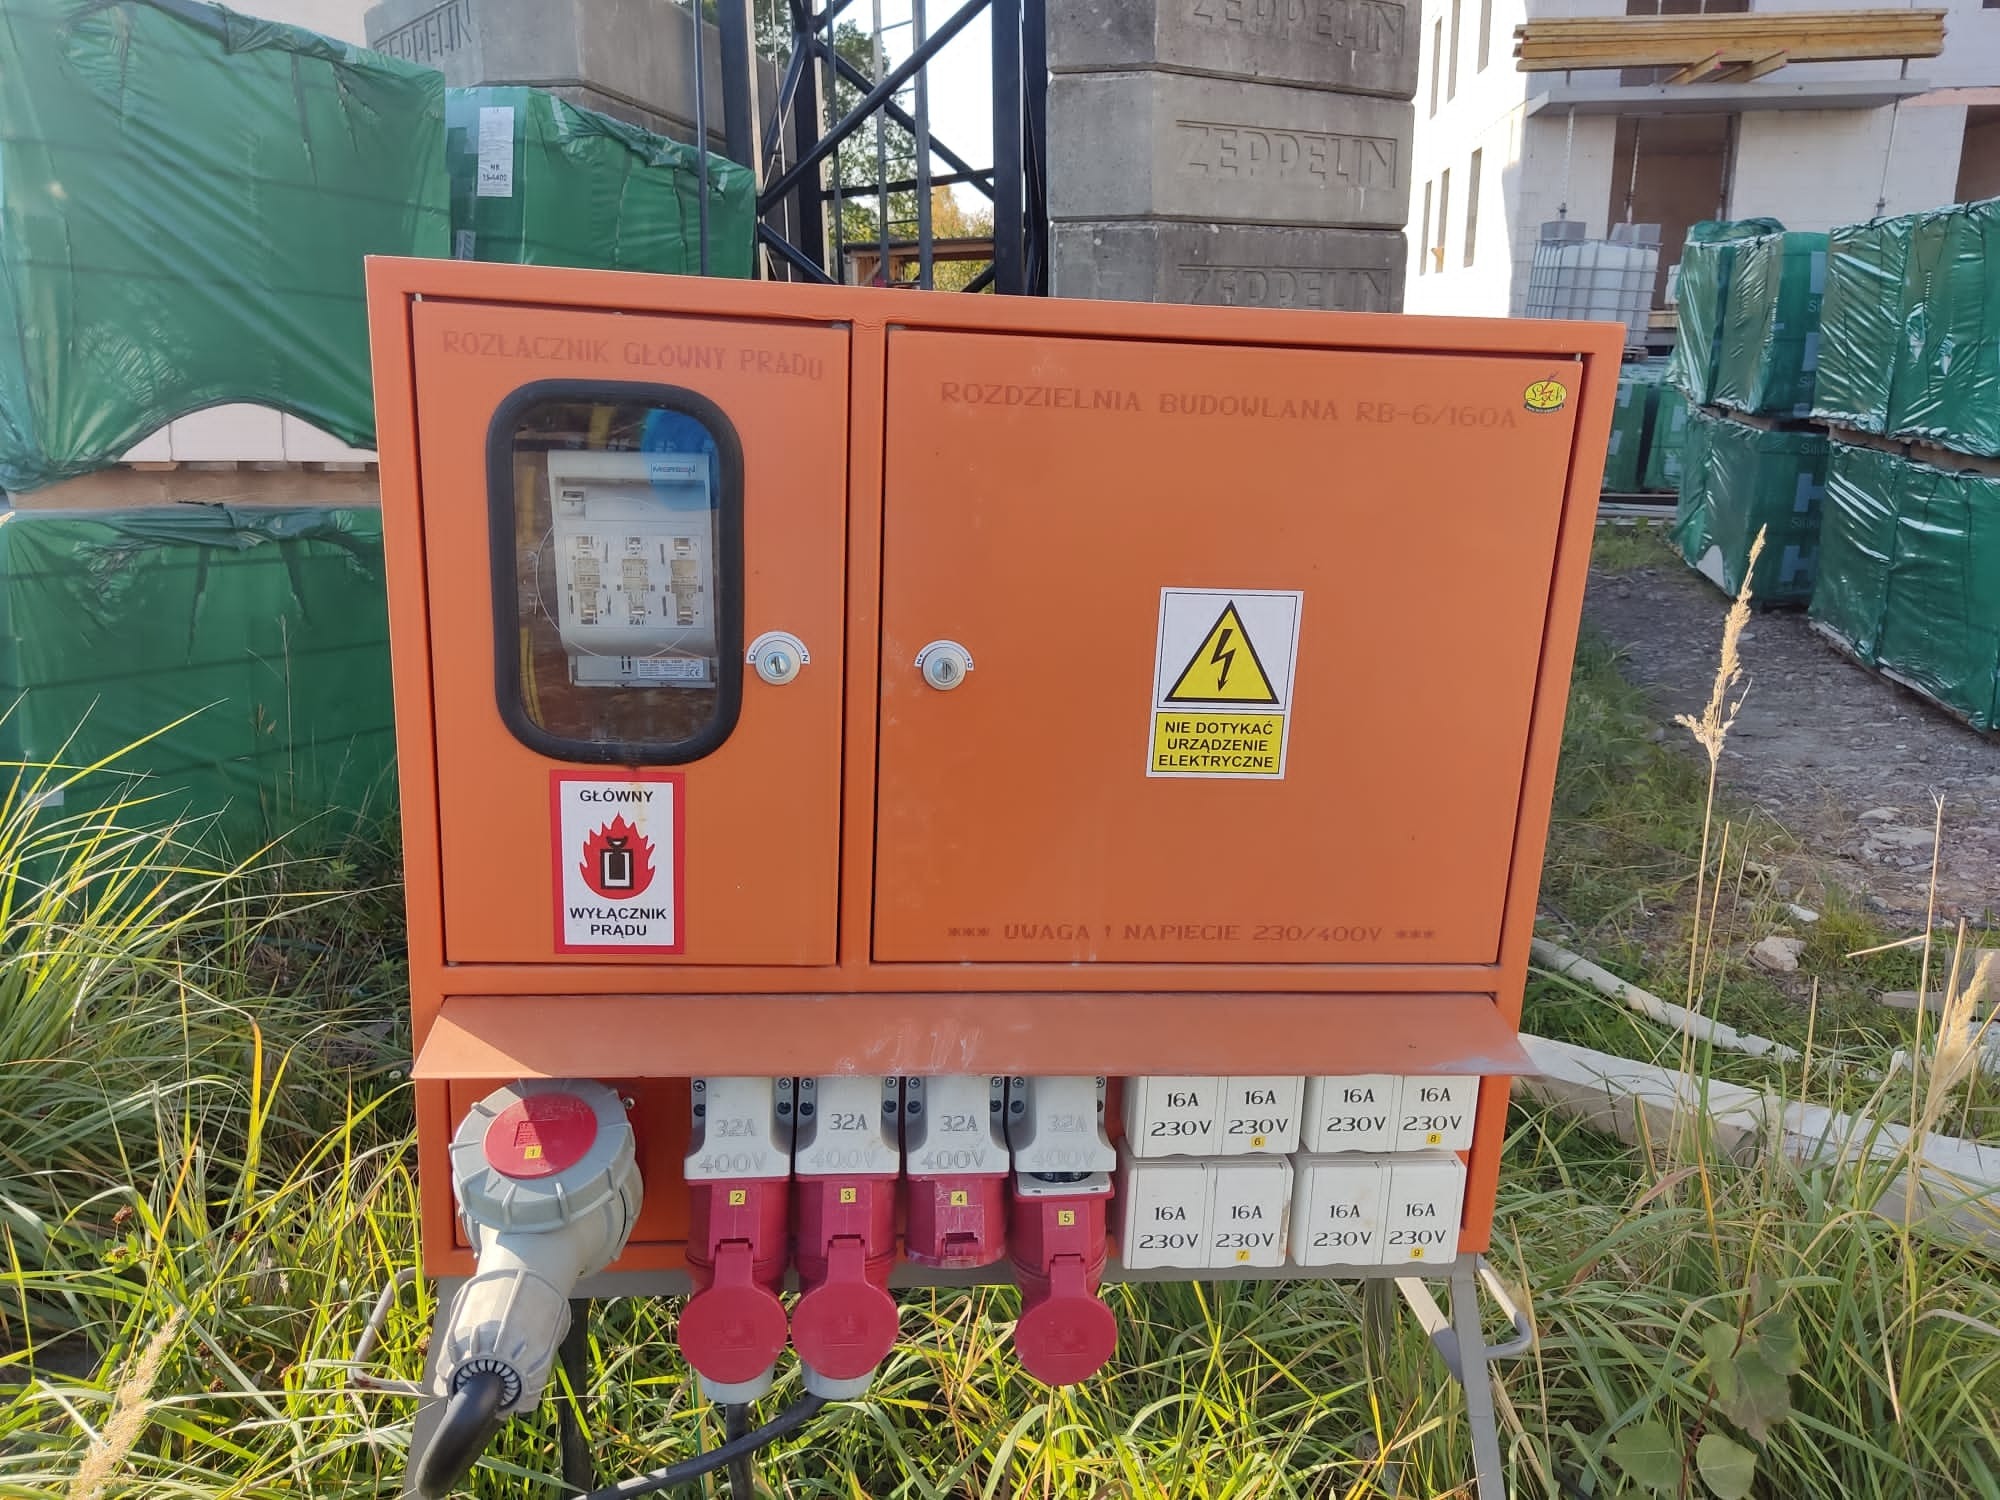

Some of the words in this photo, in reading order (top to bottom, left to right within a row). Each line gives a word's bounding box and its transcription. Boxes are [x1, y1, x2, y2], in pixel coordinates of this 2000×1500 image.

[1177, 124, 1398, 188] ZEPPELIN
[1178, 267, 1392, 311] ZEPPELIN
[740, 348, 824, 381] PRADU
[941, 382, 1143, 412] ROZDZIELNIA
[1159, 393, 1338, 421] BUDOWLANA
[1355, 401, 1517, 429] RB-6/160A
[1165, 722, 1191, 734] NIE
[1196, 721, 1273, 735] DOTYKAĆ
[1167, 738, 1268, 753] URZĄDZENIE
[1159, 754, 1273, 768] ELEKTRYCZNE
[580, 788, 653, 802] GŁÓWNY
[570, 907, 666, 922] WYŁĄCZNIK
[590, 924, 647, 938] PRĄDU
[1004, 924, 1090, 940] UWAGA
[1123, 925, 1240, 941] NAPIECIE
[1252, 925, 1383, 942] 230/400V
[1167, 1092, 1199, 1108] 16A
[1245, 1090, 1276, 1105] 16A
[1343, 1088, 1375, 1103] 16A
[1420, 1087, 1451, 1102] 16A
[716, 1119, 757, 1137] 32A
[829, 1113, 868, 1131] 32A
[939, 1114, 979, 1132] 32A
[1151, 1119, 1212, 1137] 230V
[1228, 1118, 1289, 1135] 230V
[1327, 1116, 1386, 1132] 230V
[1402, 1115, 1462, 1131] 230V
[1254, 1138, 1261, 1146] 6
[1430, 1134, 1437, 1143] 8
[699, 1151, 767, 1174] 400V
[920, 1150, 986, 1170] 400V
[735, 1192, 742, 1203] 2
[844, 1190, 852, 1201] 3
[955, 1193, 963, 1204] 4
[1063, 1212, 1070, 1223] 5
[1155, 1206, 1186, 1221] 16A
[1231, 1205, 1262, 1220] 16A
[1330, 1204, 1361, 1219] 16A
[1406, 1203, 1436, 1217] 16A
[1139, 1233, 1199, 1249] 230V
[1215, 1232, 1275, 1248] 230V
[1313, 1231, 1372, 1247] 230V
[1388, 1229, 1447, 1245] 230V
[1414, 1249, 1421, 1257] 9
